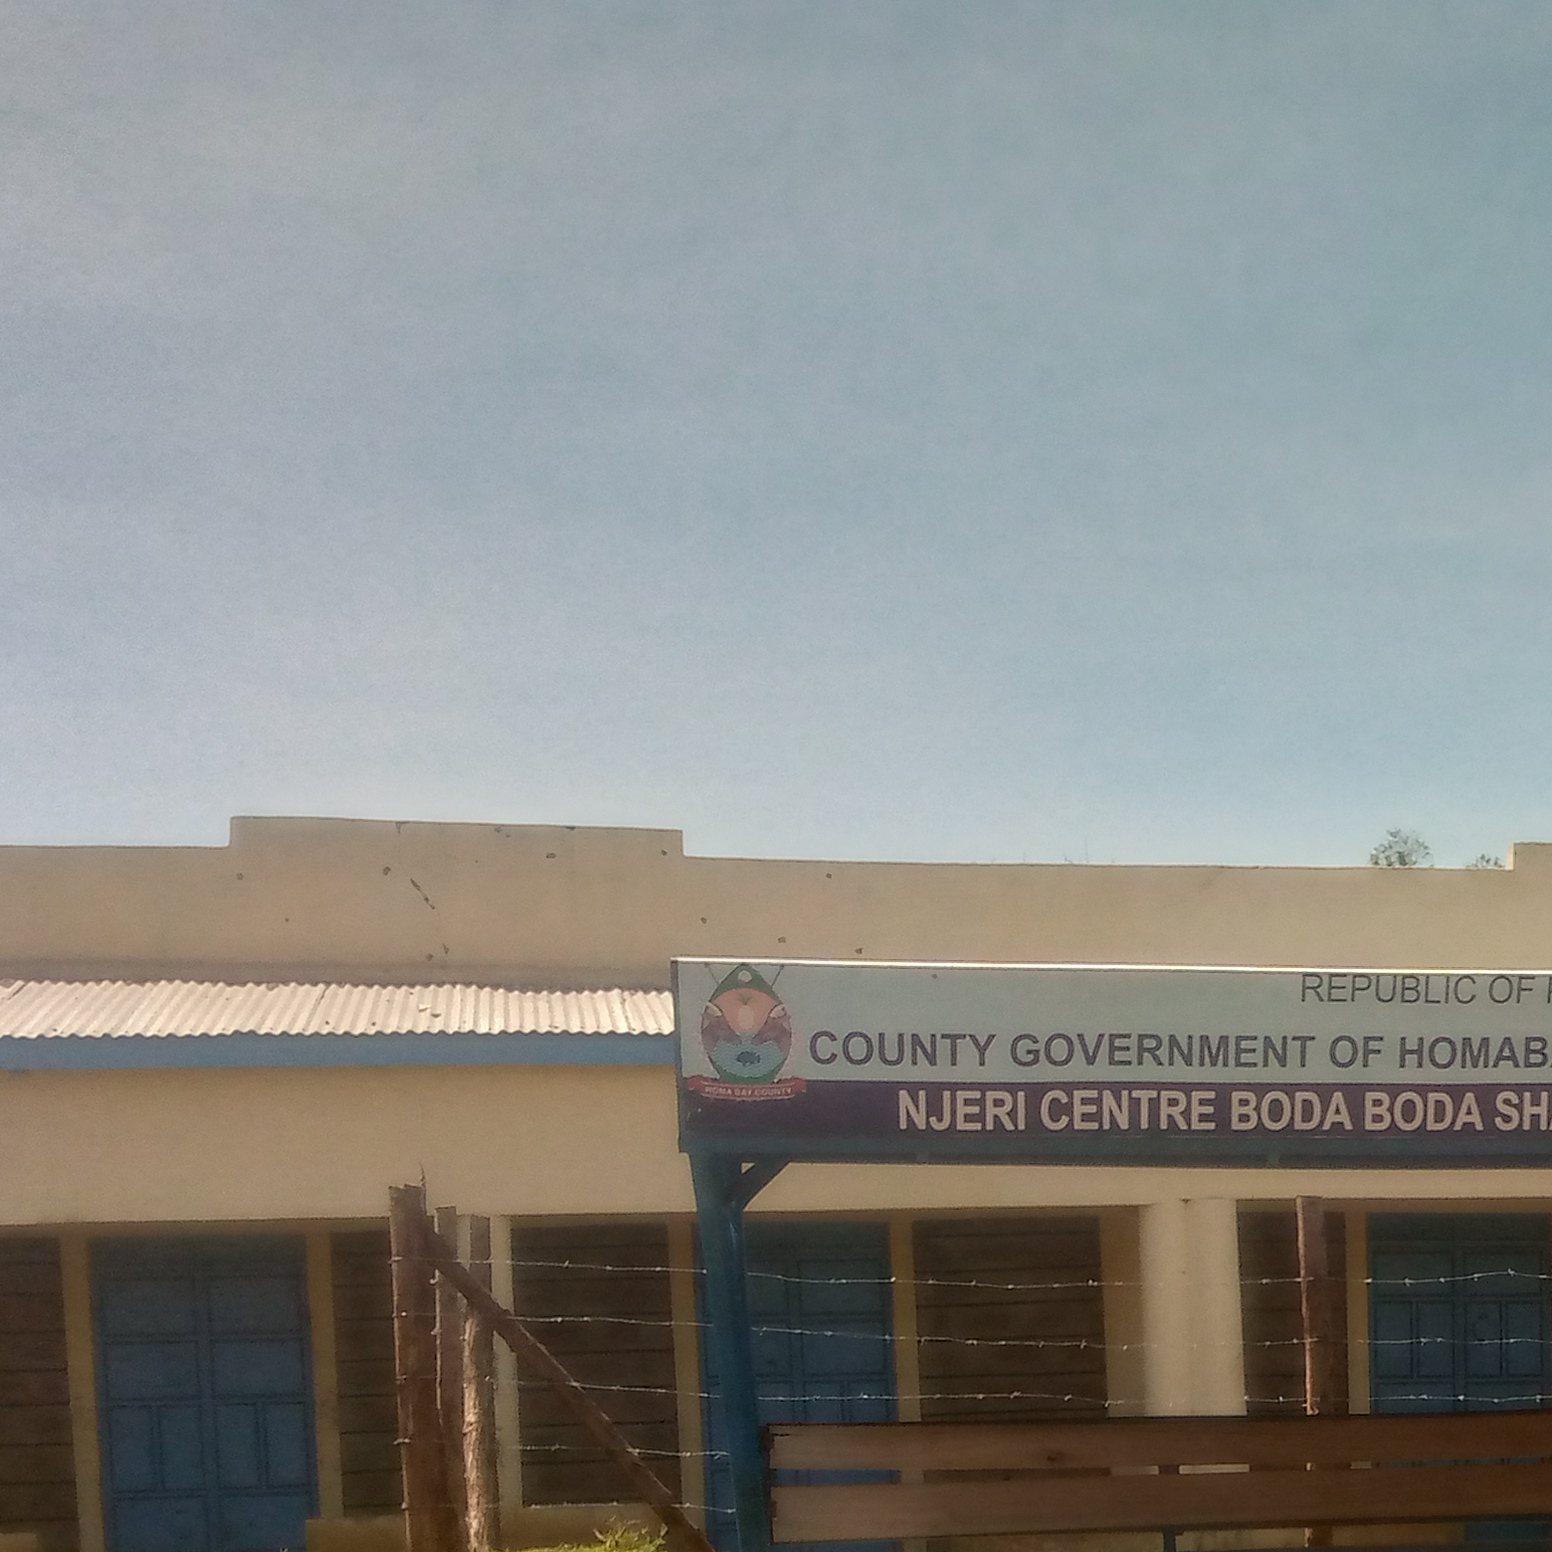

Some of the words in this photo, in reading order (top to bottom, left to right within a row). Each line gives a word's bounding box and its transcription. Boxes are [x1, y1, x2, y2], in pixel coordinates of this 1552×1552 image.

[1301, 974, 1477, 1004] REPUBLIC
[1487, 974, 1536, 1005] OF
[808, 1030, 997, 1068] COUNTY
[1009, 1032, 1317, 1070] GOVERNMENT
[1328, 1036, 1384, 1070] OF
[898, 1090, 1027, 1132] NJERI
[1039, 1090, 1217, 1132] CENTRE
[1229, 1089, 1354, 1132] BODA
[1363, 1089, 1484, 1132] BODA
